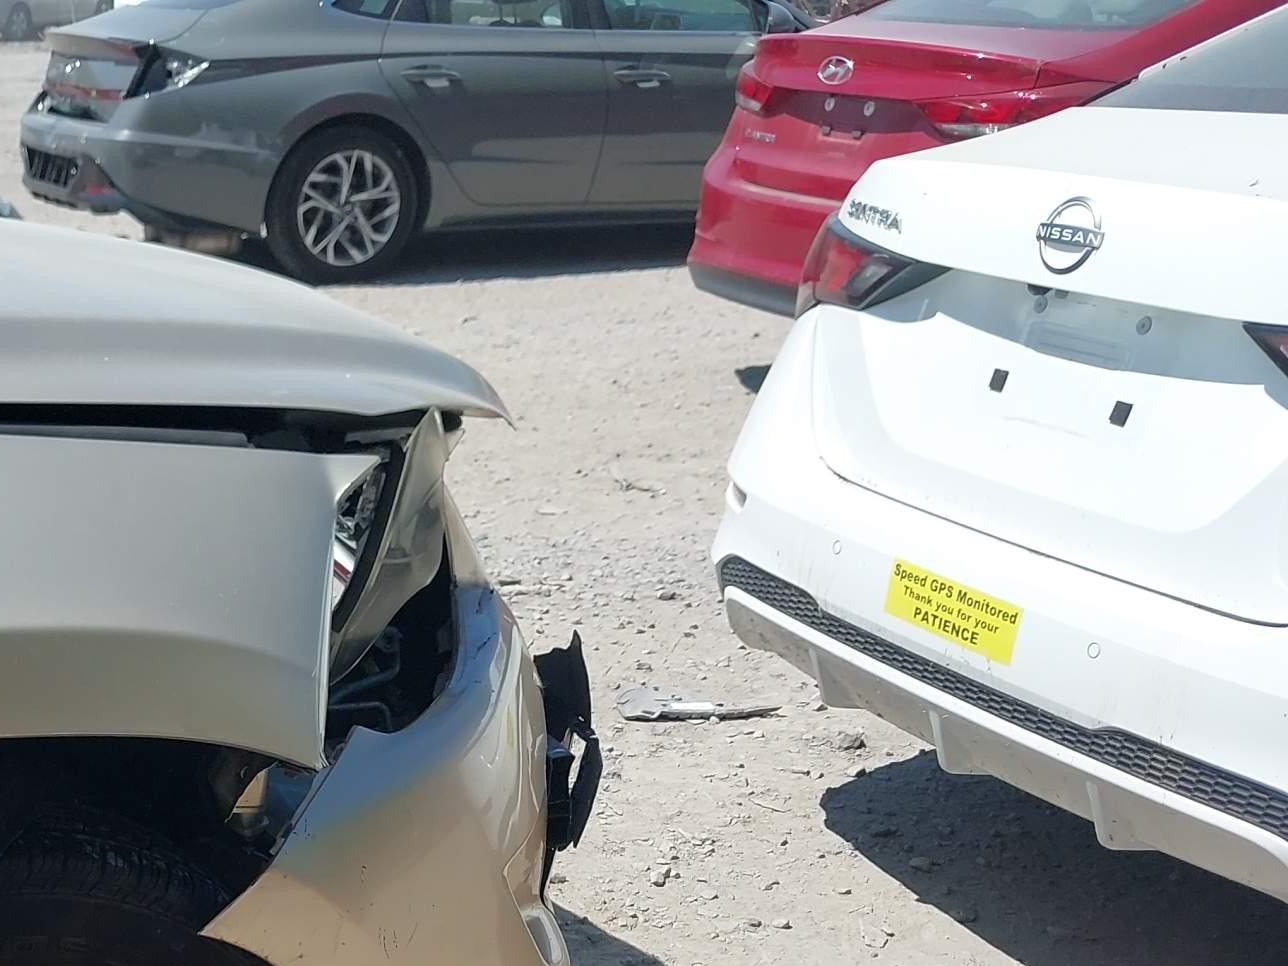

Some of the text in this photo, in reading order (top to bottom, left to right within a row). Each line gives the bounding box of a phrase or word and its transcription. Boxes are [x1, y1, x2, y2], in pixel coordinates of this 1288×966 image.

[1039, 225, 1101, 247] NISSAN
[894, 563, 1019, 625] Speed GPS Monitored
[903, 585, 1000, 635] Thank you for your
[913, 606, 980, 645] PATIENCE
